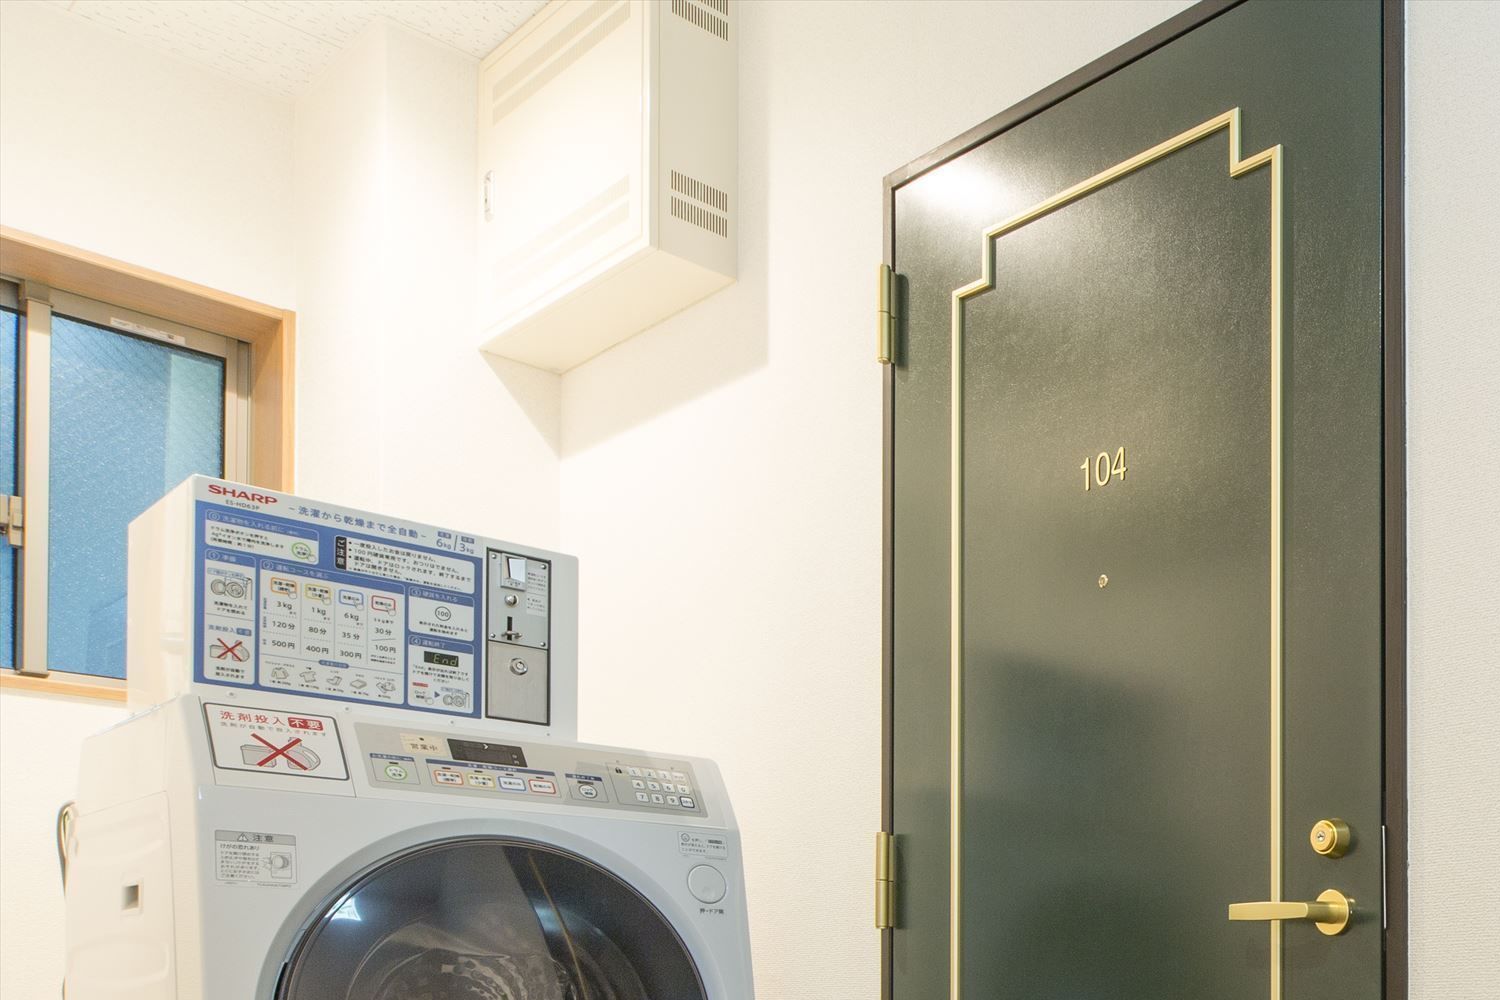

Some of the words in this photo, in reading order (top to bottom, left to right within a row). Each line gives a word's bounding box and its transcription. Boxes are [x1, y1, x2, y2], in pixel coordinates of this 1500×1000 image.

[1080, 446, 1128, 491] 104
[208, 484, 278, 505] SHARP
[433, 653, 457, 667] End
[220, 711, 285, 726] 洗剤投入
[291, 719, 322, 731] 不要
